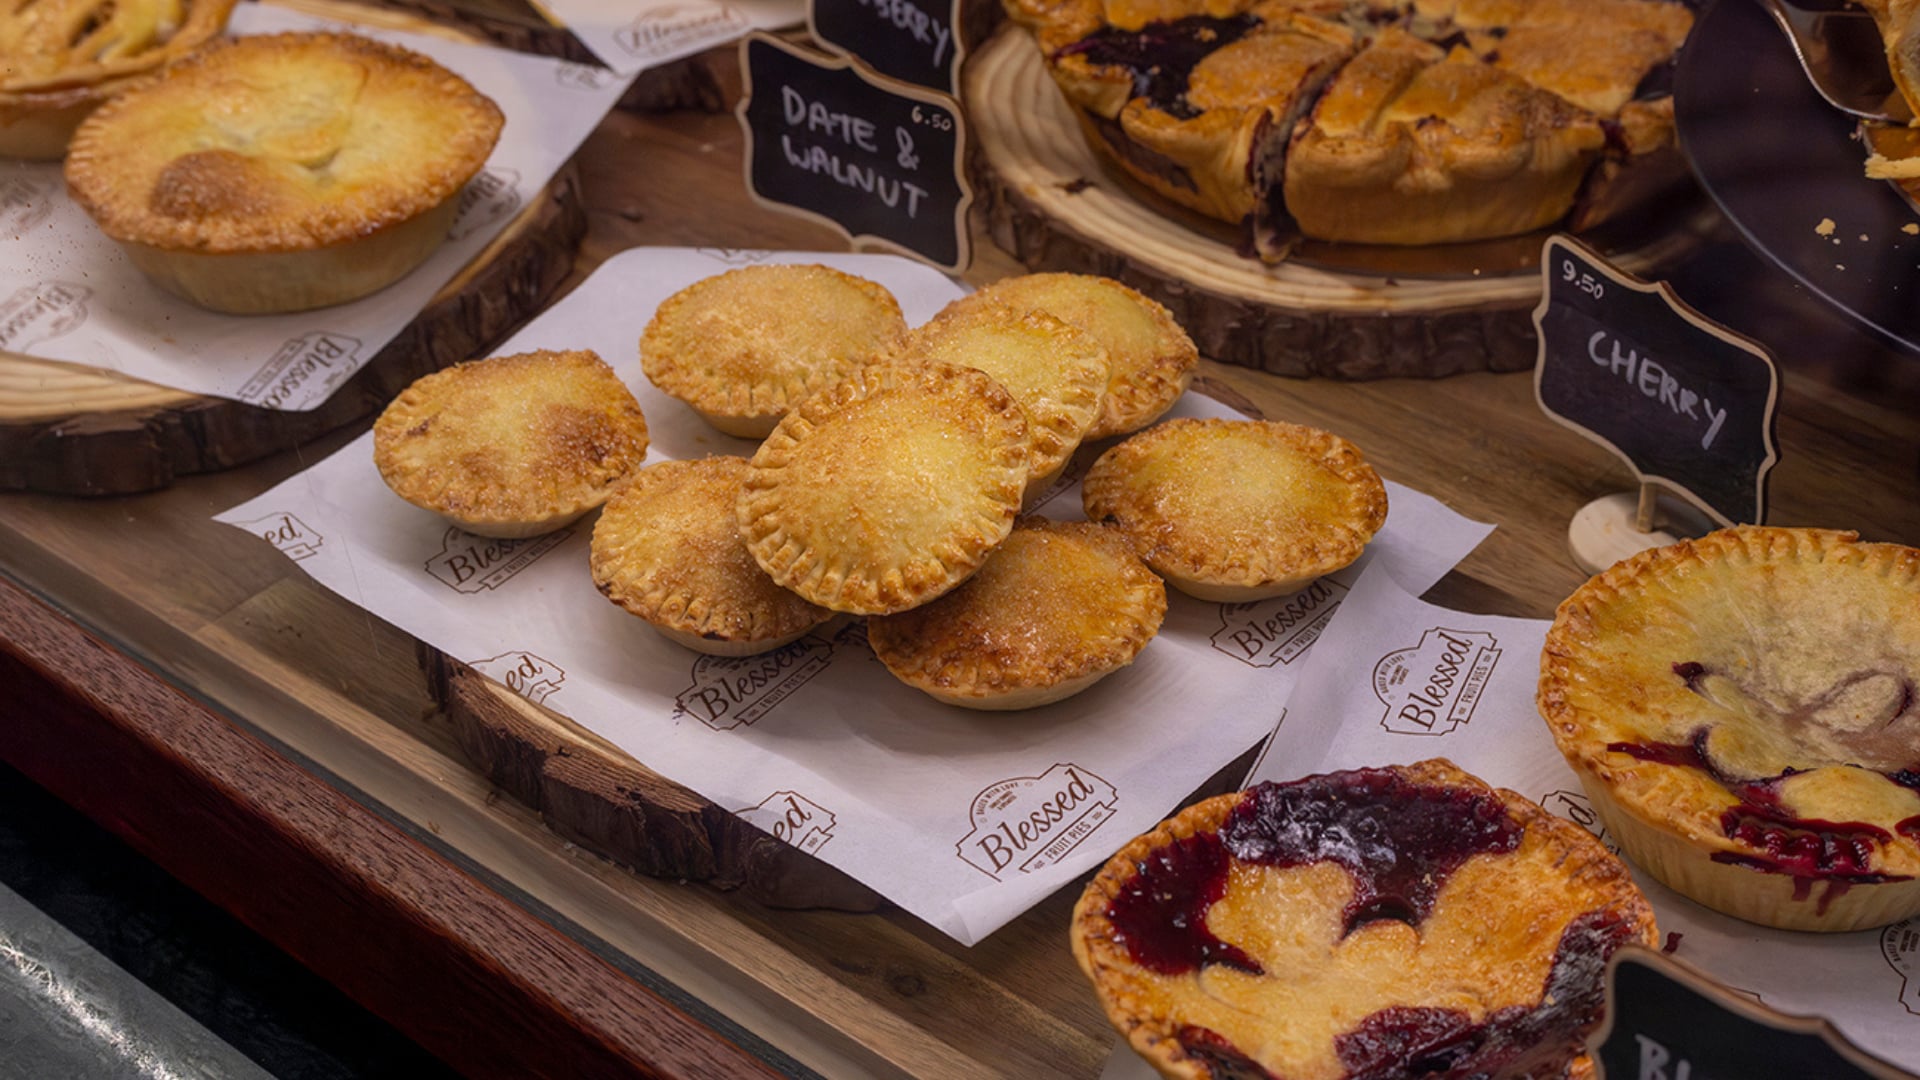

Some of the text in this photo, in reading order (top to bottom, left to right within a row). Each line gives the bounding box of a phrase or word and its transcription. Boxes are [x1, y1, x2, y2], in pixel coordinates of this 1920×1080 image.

[859, 0, 949, 68] BERRY
[781, 84, 920, 171] DATE &
[911, 105, 952, 131] 6.50
[781, 134, 929, 219] WALNUT
[1562, 259, 1604, 300] 9.50
[1588, 330, 1727, 451] CHERRY
[1228, 580, 1333, 660] Blessed
[1398, 631, 1474, 732] Blessed
[976, 767, 1095, 874] Blessed
[1044, 820, 1093, 861] FRUIT PIES
